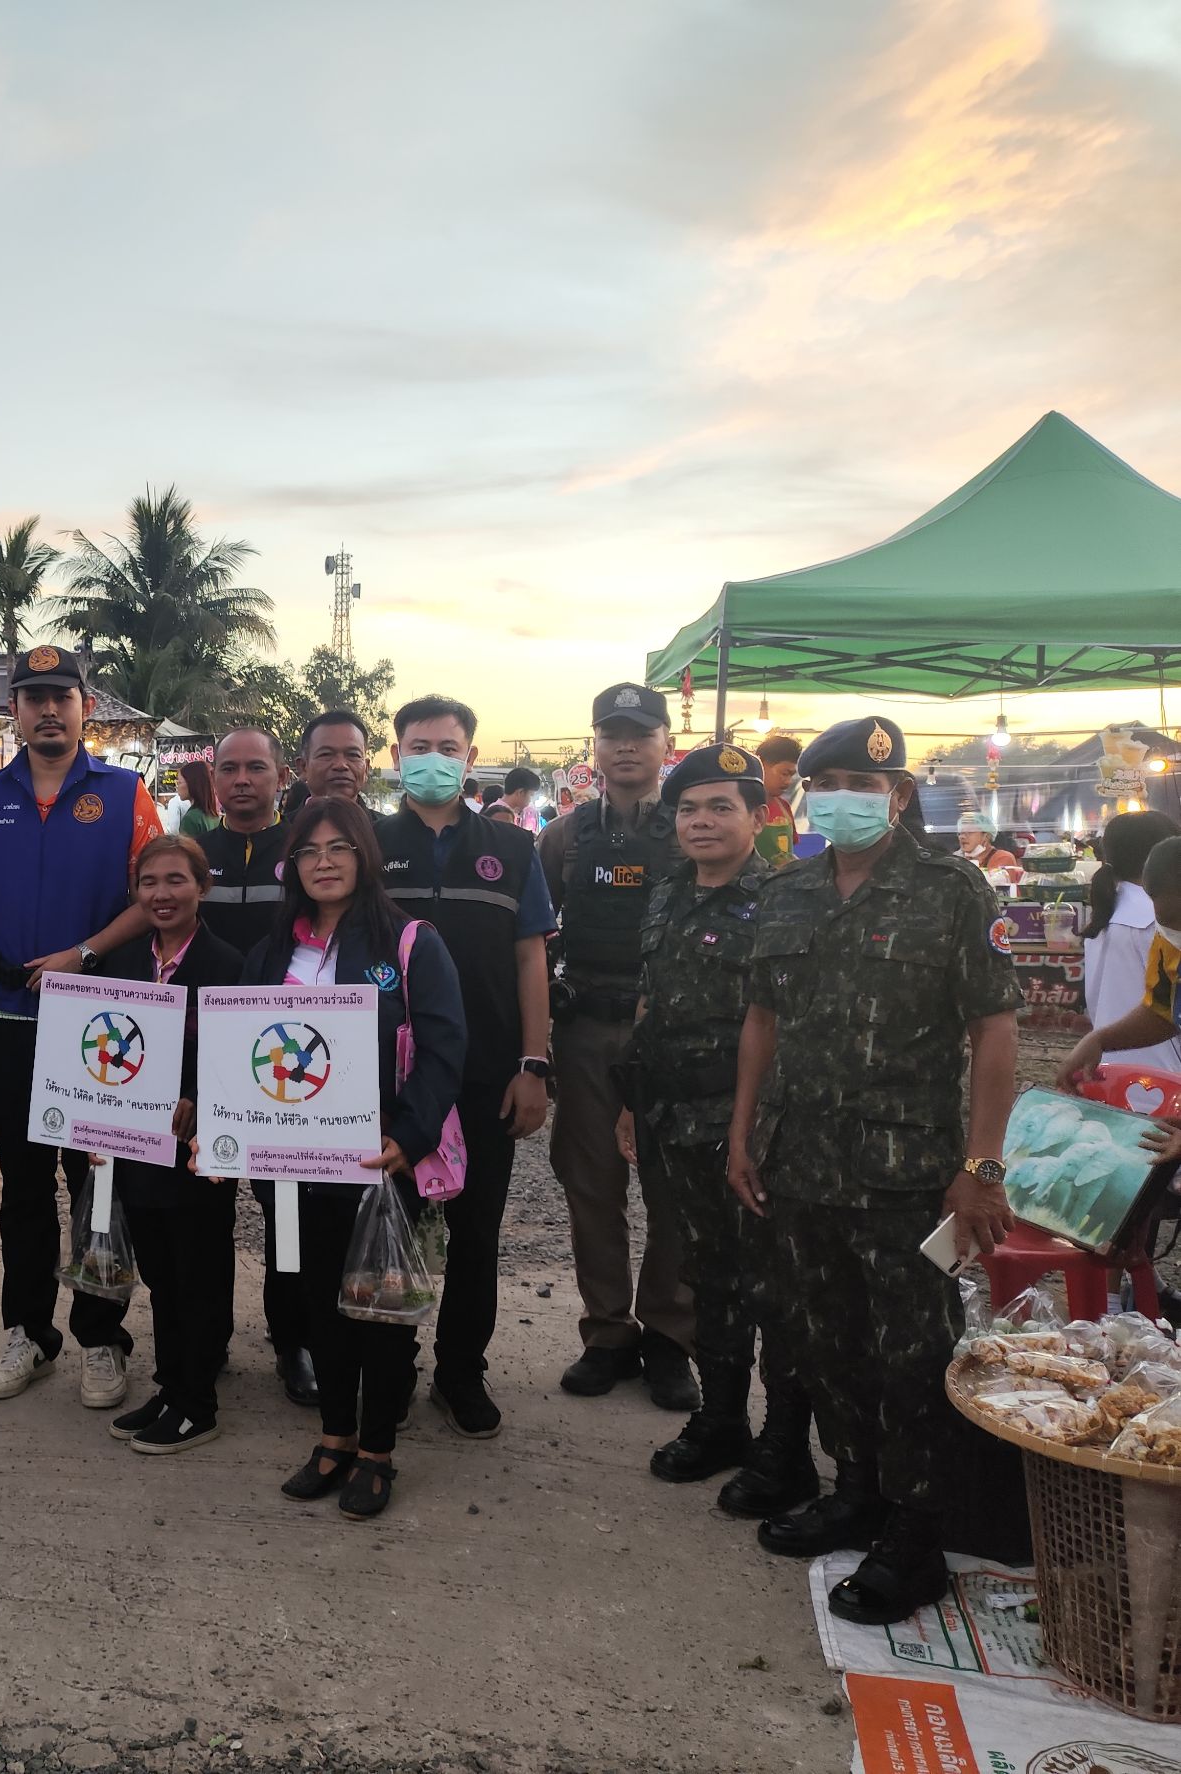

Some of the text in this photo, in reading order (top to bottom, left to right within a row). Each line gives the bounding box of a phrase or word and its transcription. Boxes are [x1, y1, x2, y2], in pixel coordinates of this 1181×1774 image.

[570, 772, 588, 786] 25
[45, 978, 175, 1004] สังคมลดขอทาน บนฐานความร่วมมือ
[204, 992, 364, 1009] สังคมลดขอทาน บนฐานความร่วมมือ
[45, 1078, 70, 1098] ให้ทาน
[73, 1087, 94, 1104] ให้คิด
[96, 1092, 123, 1109] ให้ชีวิต
[213, 1103, 243, 1122] ให้ทาน
[246, 1109, 272, 1126] ให้คิด
[275, 1112, 309, 1127] ให้ชีวิต
